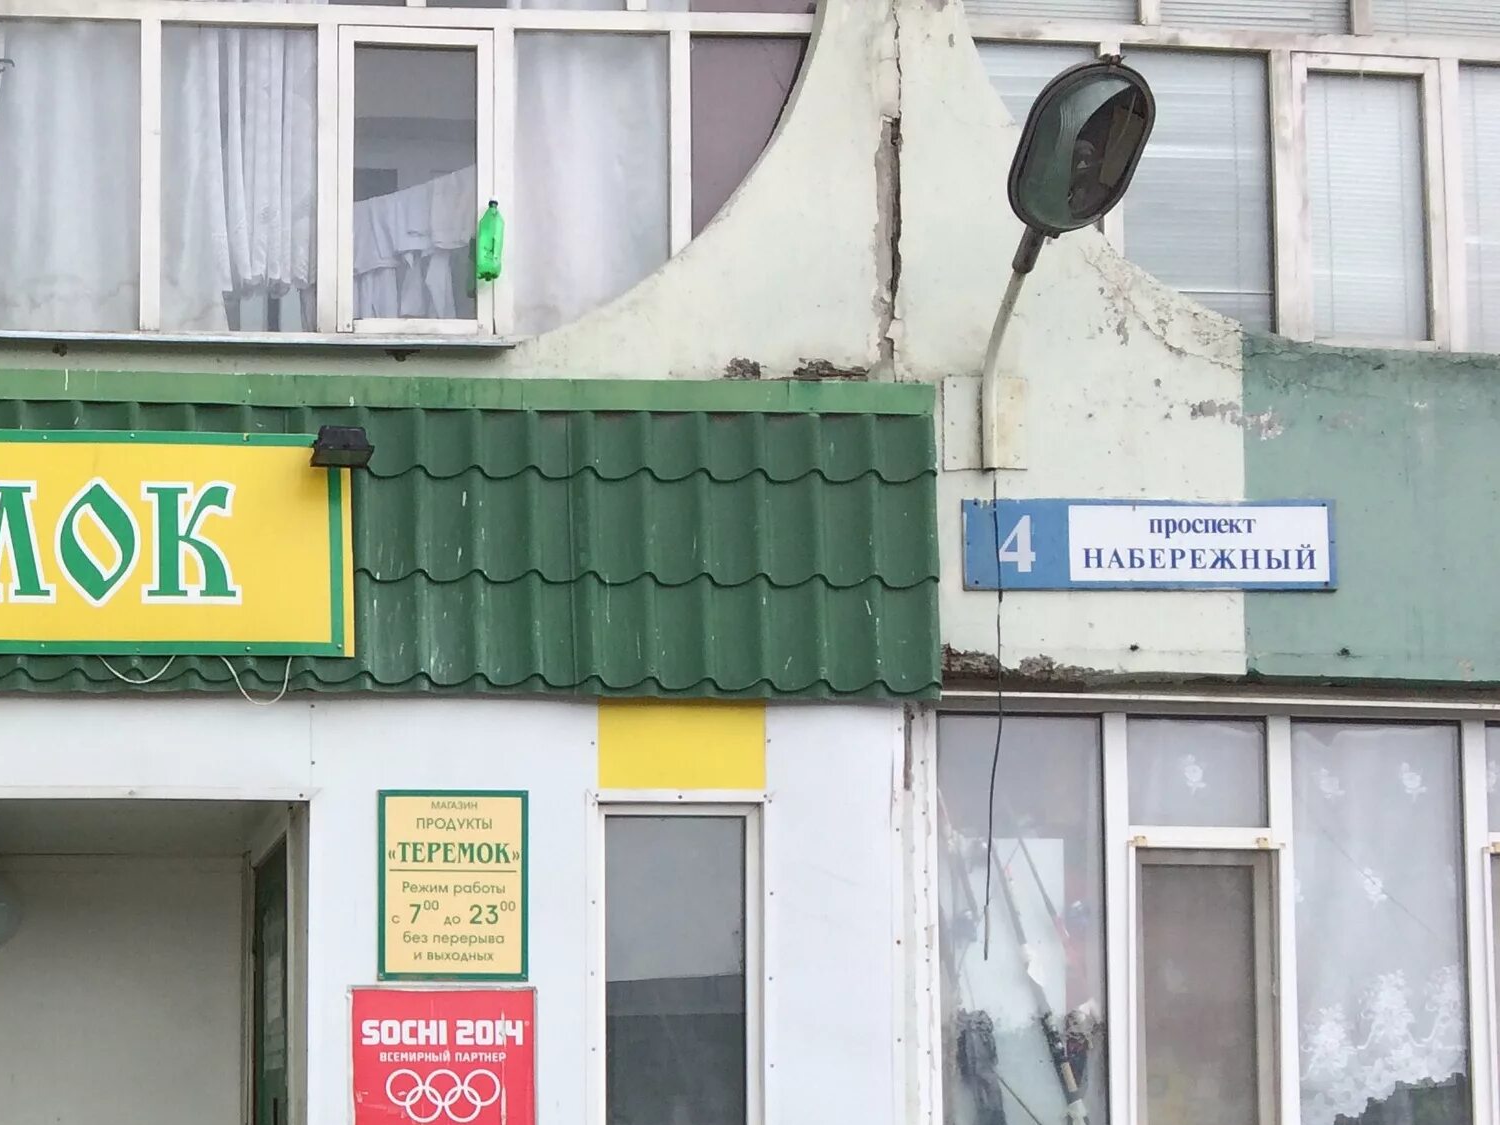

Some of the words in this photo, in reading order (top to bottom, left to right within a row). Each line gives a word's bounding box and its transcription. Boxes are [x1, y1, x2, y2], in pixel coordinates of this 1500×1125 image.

[1149, 517, 1257, 539] проспект
[999, 514, 1036, 573] 4
[1083, 544, 1317, 571] НАБЕРЕЖНЫЙ
[431, 800, 478, 811] МАГАЗИН
[416, 817, 493, 831] ПРОДУКТЫ
[402, 881, 449, 894] Режим
[453, 882, 505, 896] работы
[444, 915, 461, 926] до
[403, 931, 428, 944] без
[433, 933, 505, 946] перерыва
[414, 951, 423, 961] и
[427, 951, 494, 962] выходных
[361, 1019, 448, 1046] SOCHI
[455, 1019, 524, 1046] 2014
[379, 1050, 451, 1063] ВСЕМИРНЫЙ
[455, 1052, 507, 1063] ПАРТНЕР
